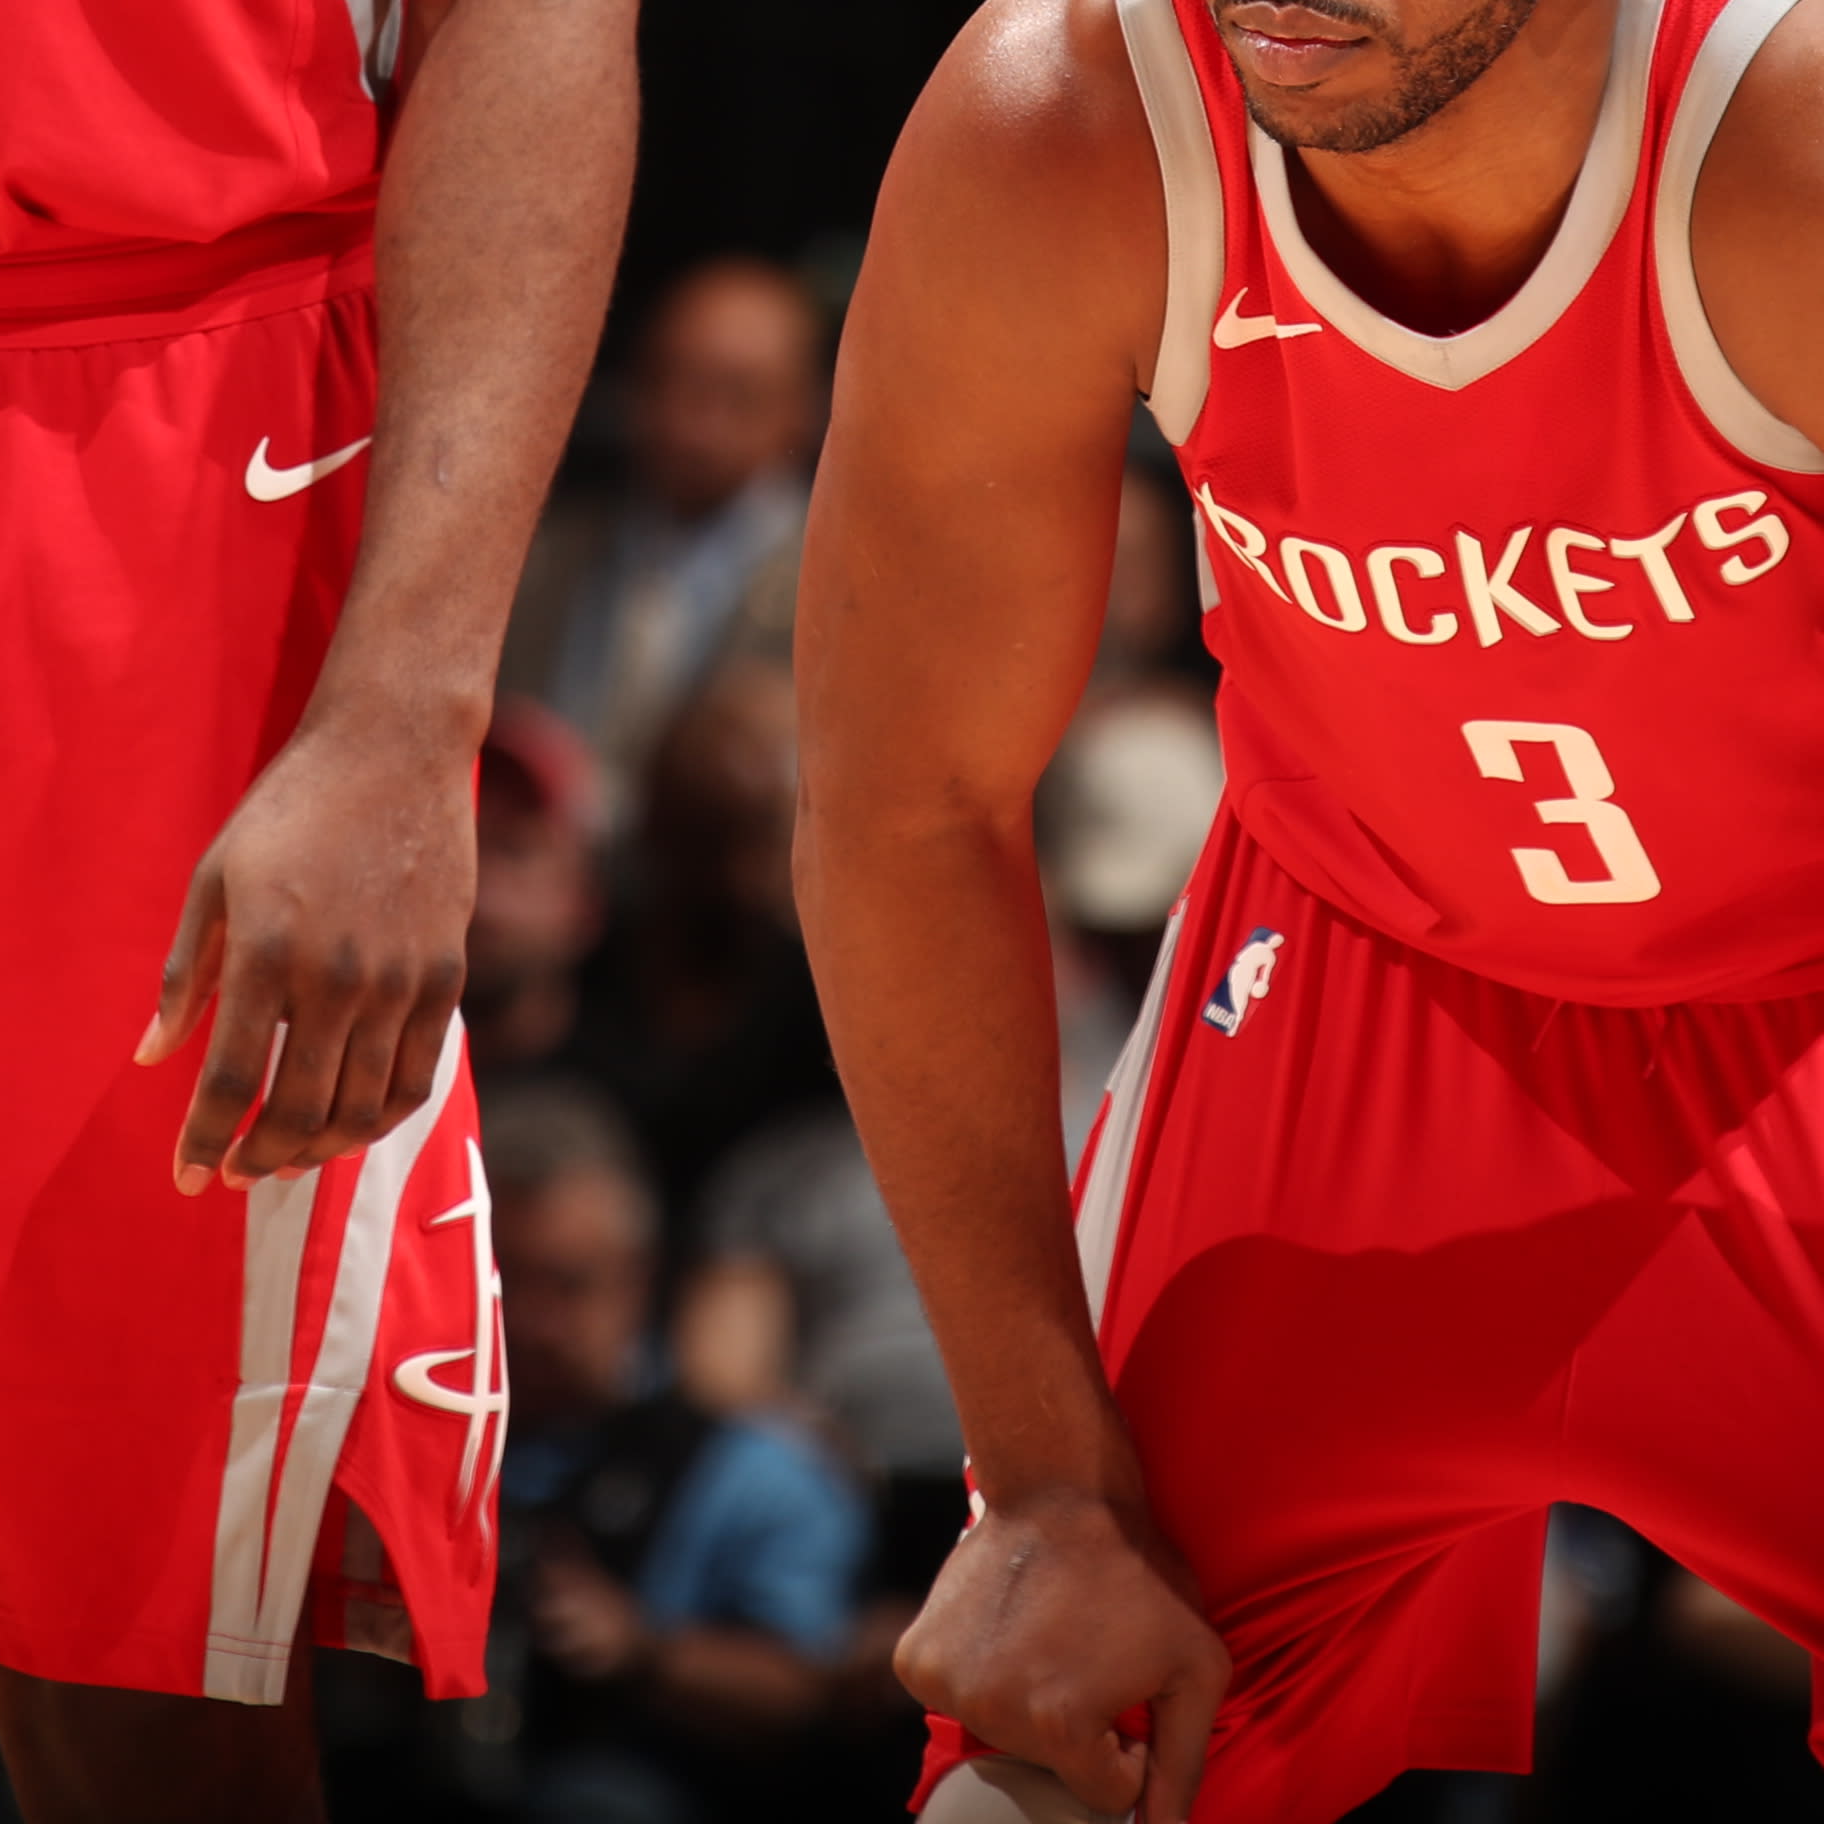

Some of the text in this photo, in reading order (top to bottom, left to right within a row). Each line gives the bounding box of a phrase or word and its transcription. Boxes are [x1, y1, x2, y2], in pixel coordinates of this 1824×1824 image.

[1193, 481, 1790, 648] ROCKETS
[1461, 719, 1662, 905] 3
[1204, 1002, 1237, 1029] NBA
